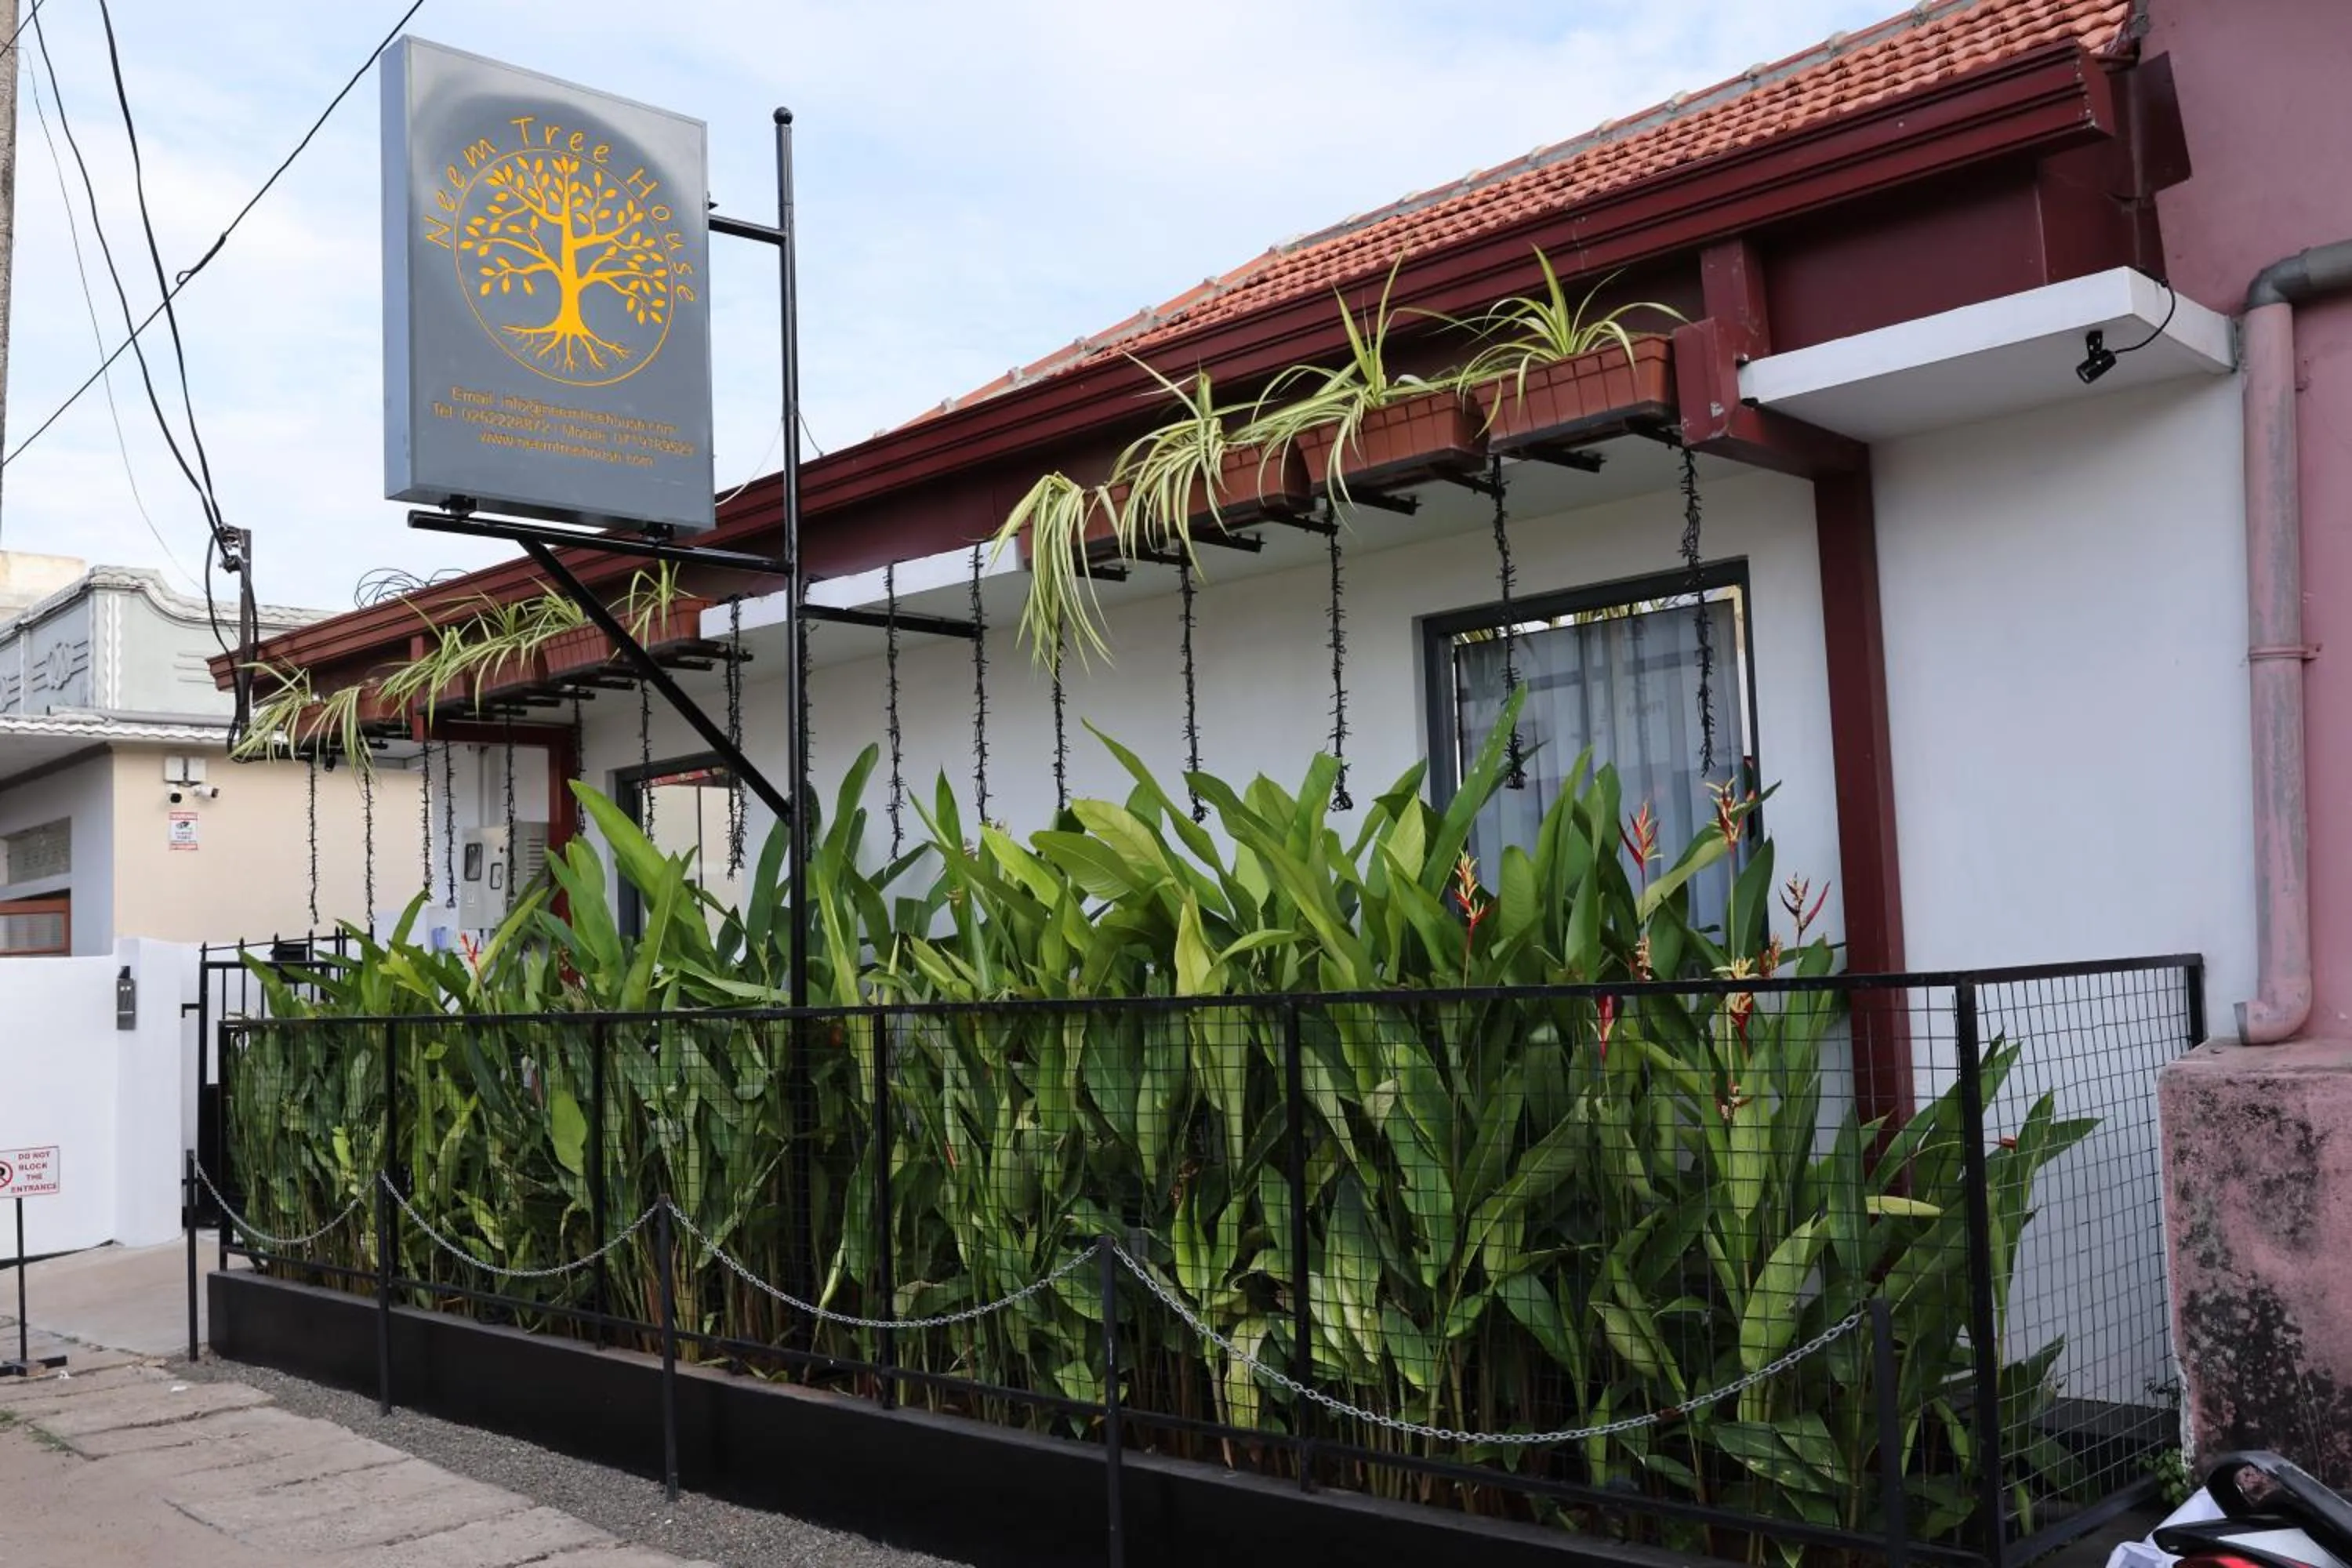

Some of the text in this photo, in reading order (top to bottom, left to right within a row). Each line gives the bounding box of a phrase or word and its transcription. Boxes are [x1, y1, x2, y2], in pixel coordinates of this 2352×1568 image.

[423, 114, 695, 303] Neem Tree House
[11, 1183, 56, 1192] ENTRANCE
